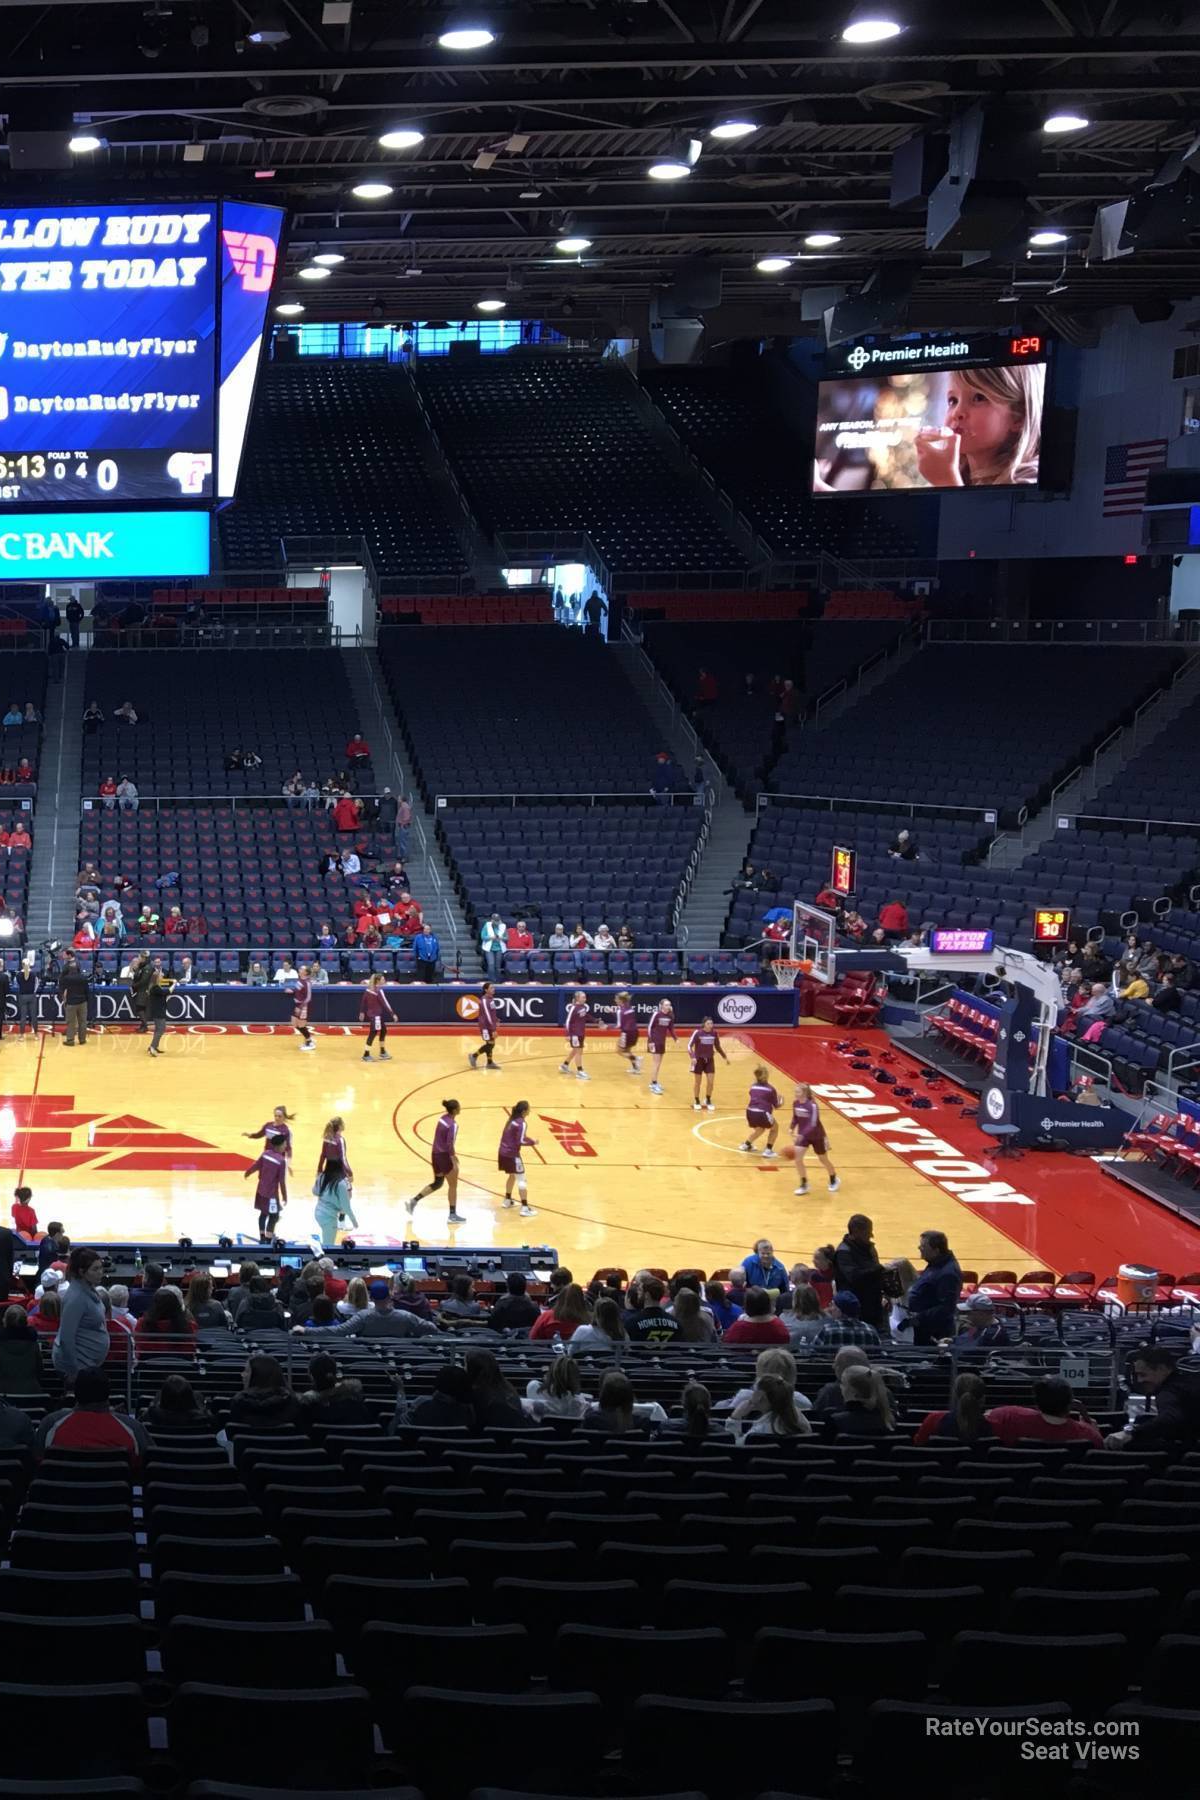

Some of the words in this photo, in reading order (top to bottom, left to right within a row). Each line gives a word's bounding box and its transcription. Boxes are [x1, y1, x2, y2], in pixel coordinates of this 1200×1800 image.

[101, 214, 211, 245] RUDY
[80, 257, 208, 289] TODAY
[13, 338, 197, 360] DaytonRudyFlyer
[872, 346, 922, 362] Premier
[924, 342, 969, 358] Health
[1011, 337, 1040, 354] 1:29
[14, 392, 200, 415] DaytonRudyFlyer
[48, 452, 71, 460] FOULS
[54, 462, 66, 479] 0
[76, 462, 88, 478] 4
[97, 459, 119, 490] 0
[936, 932, 987, 942] DAYTON
[1042, 923, 1060, 936] 30
[938, 941, 984, 951] FLYERS
[492, 997, 544, 1018] PNC
[721, 997, 753, 1020] Kroger
[1054, 1120, 1080, 1128] Premier
[1081, 1120, 1104, 1128] Health
[809, 1083, 1036, 1205] DAYTON
[638, 1317, 679, 1330] HOMETOWN
[1062, 1369, 1085, 1378] 104
